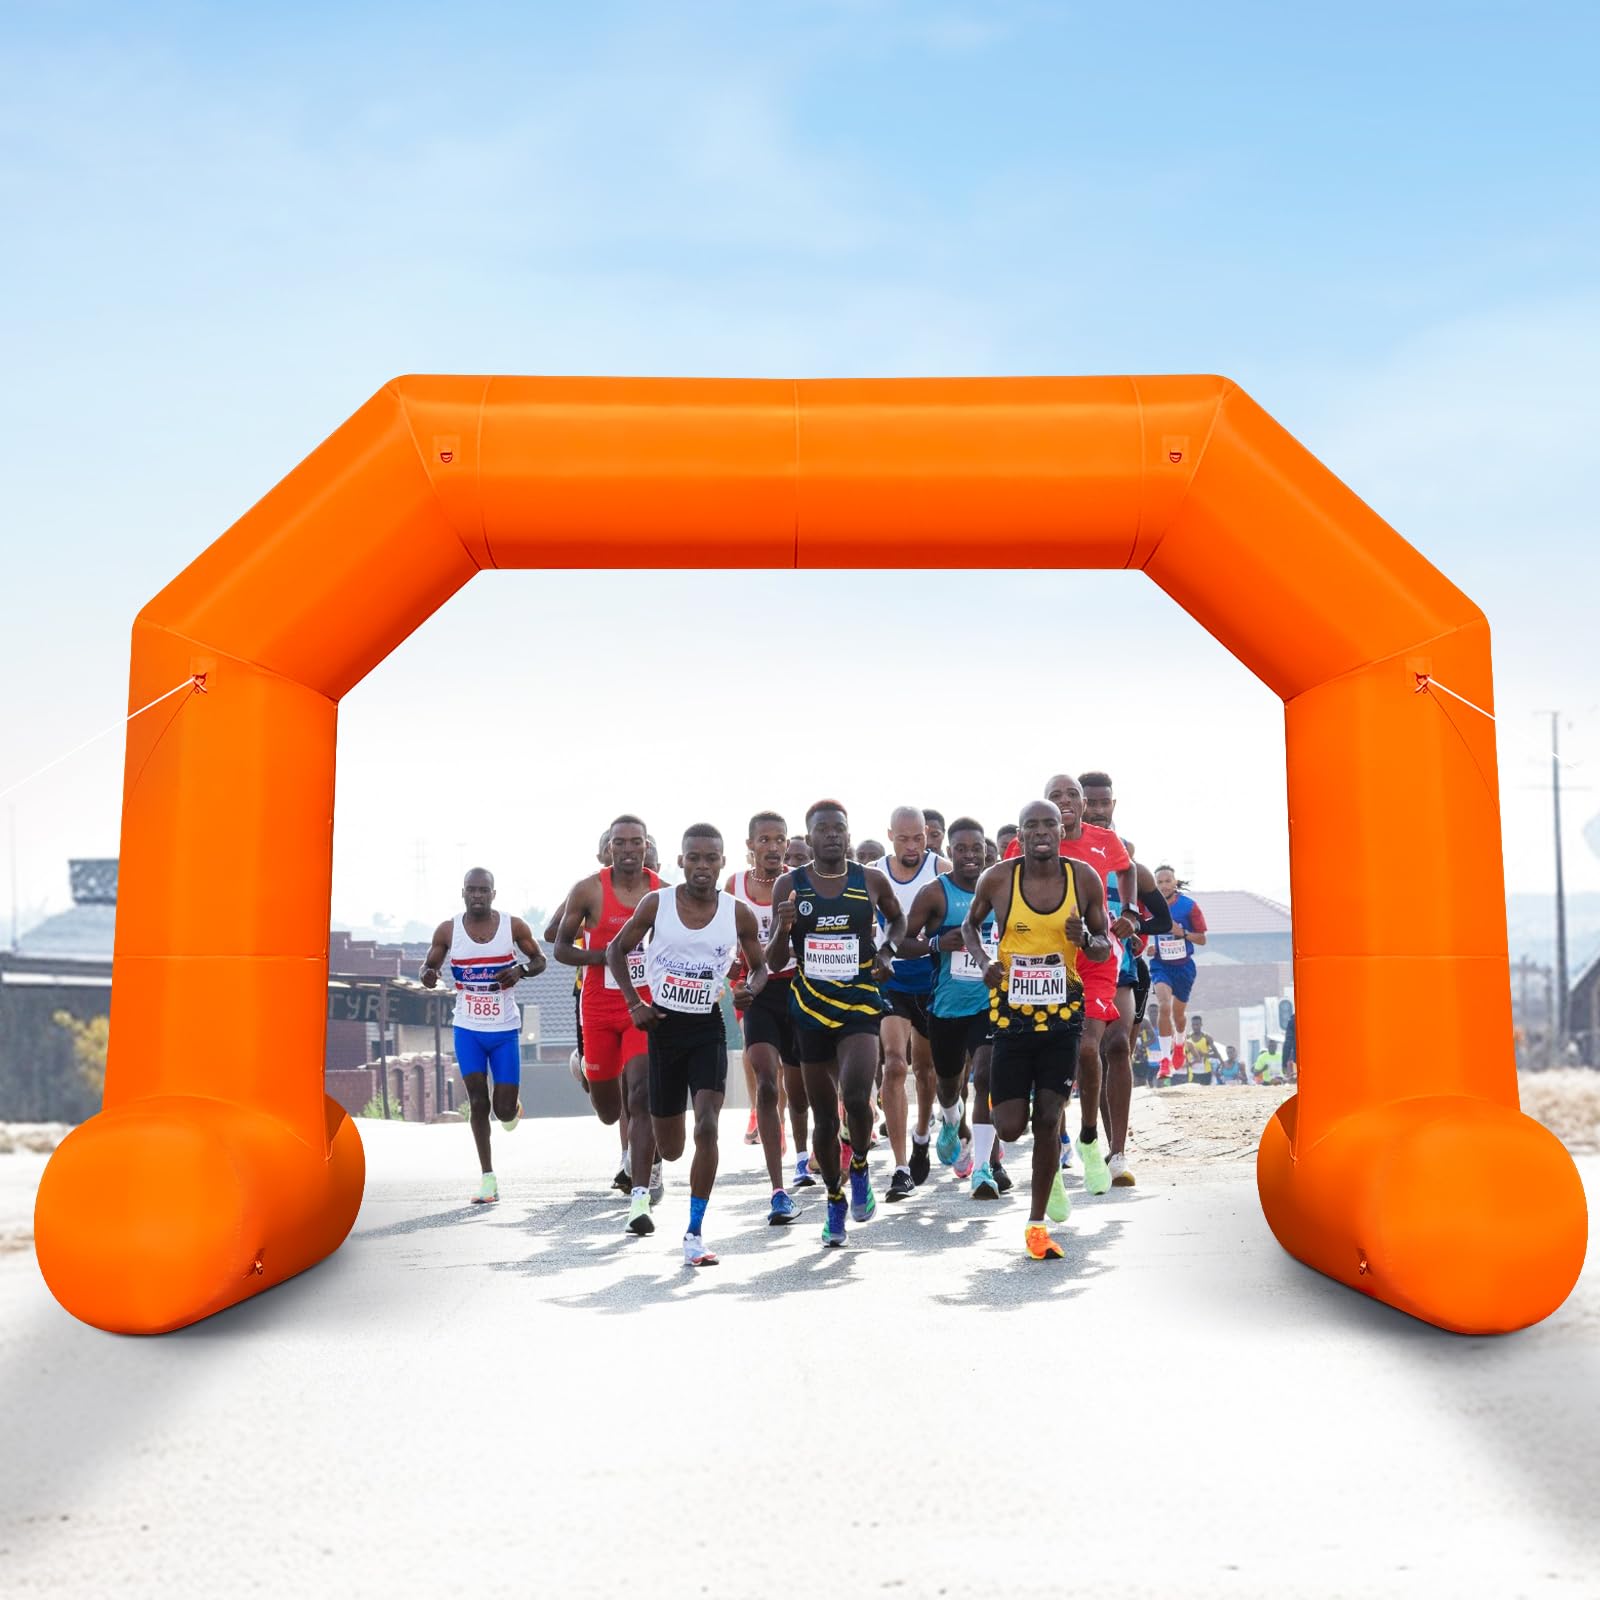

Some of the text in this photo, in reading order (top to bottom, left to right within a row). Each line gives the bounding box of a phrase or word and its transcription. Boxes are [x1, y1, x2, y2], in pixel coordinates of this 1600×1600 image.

[816, 914, 850, 927] 32Gi
[806, 952, 857, 964] MAYIBONGWE
[631, 964, 645, 980] 39
[673, 979, 703, 988] SPAR
[1012, 978, 1063, 995] PHILANI
[661, 984, 712, 1005] SAMUEL
[467, 1002, 501, 1016] 1885
